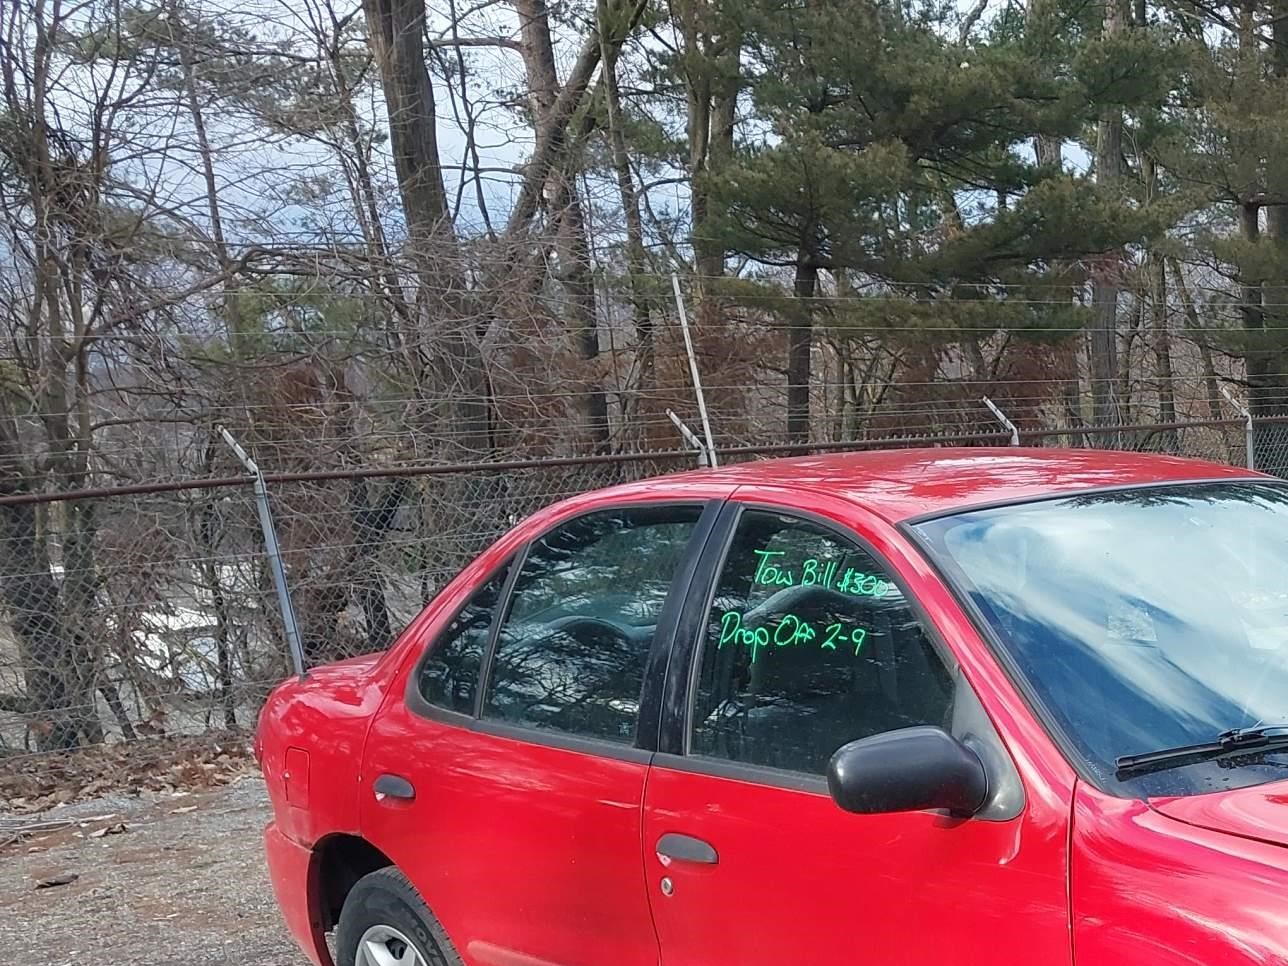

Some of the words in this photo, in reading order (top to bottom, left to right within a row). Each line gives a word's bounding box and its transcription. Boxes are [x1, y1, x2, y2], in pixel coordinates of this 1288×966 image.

[754, 549, 793, 585] Tow
[800, 558, 836, 588] Bill
[717, 611, 769, 664] Drop
[820, 623, 866, 656] 2-9
